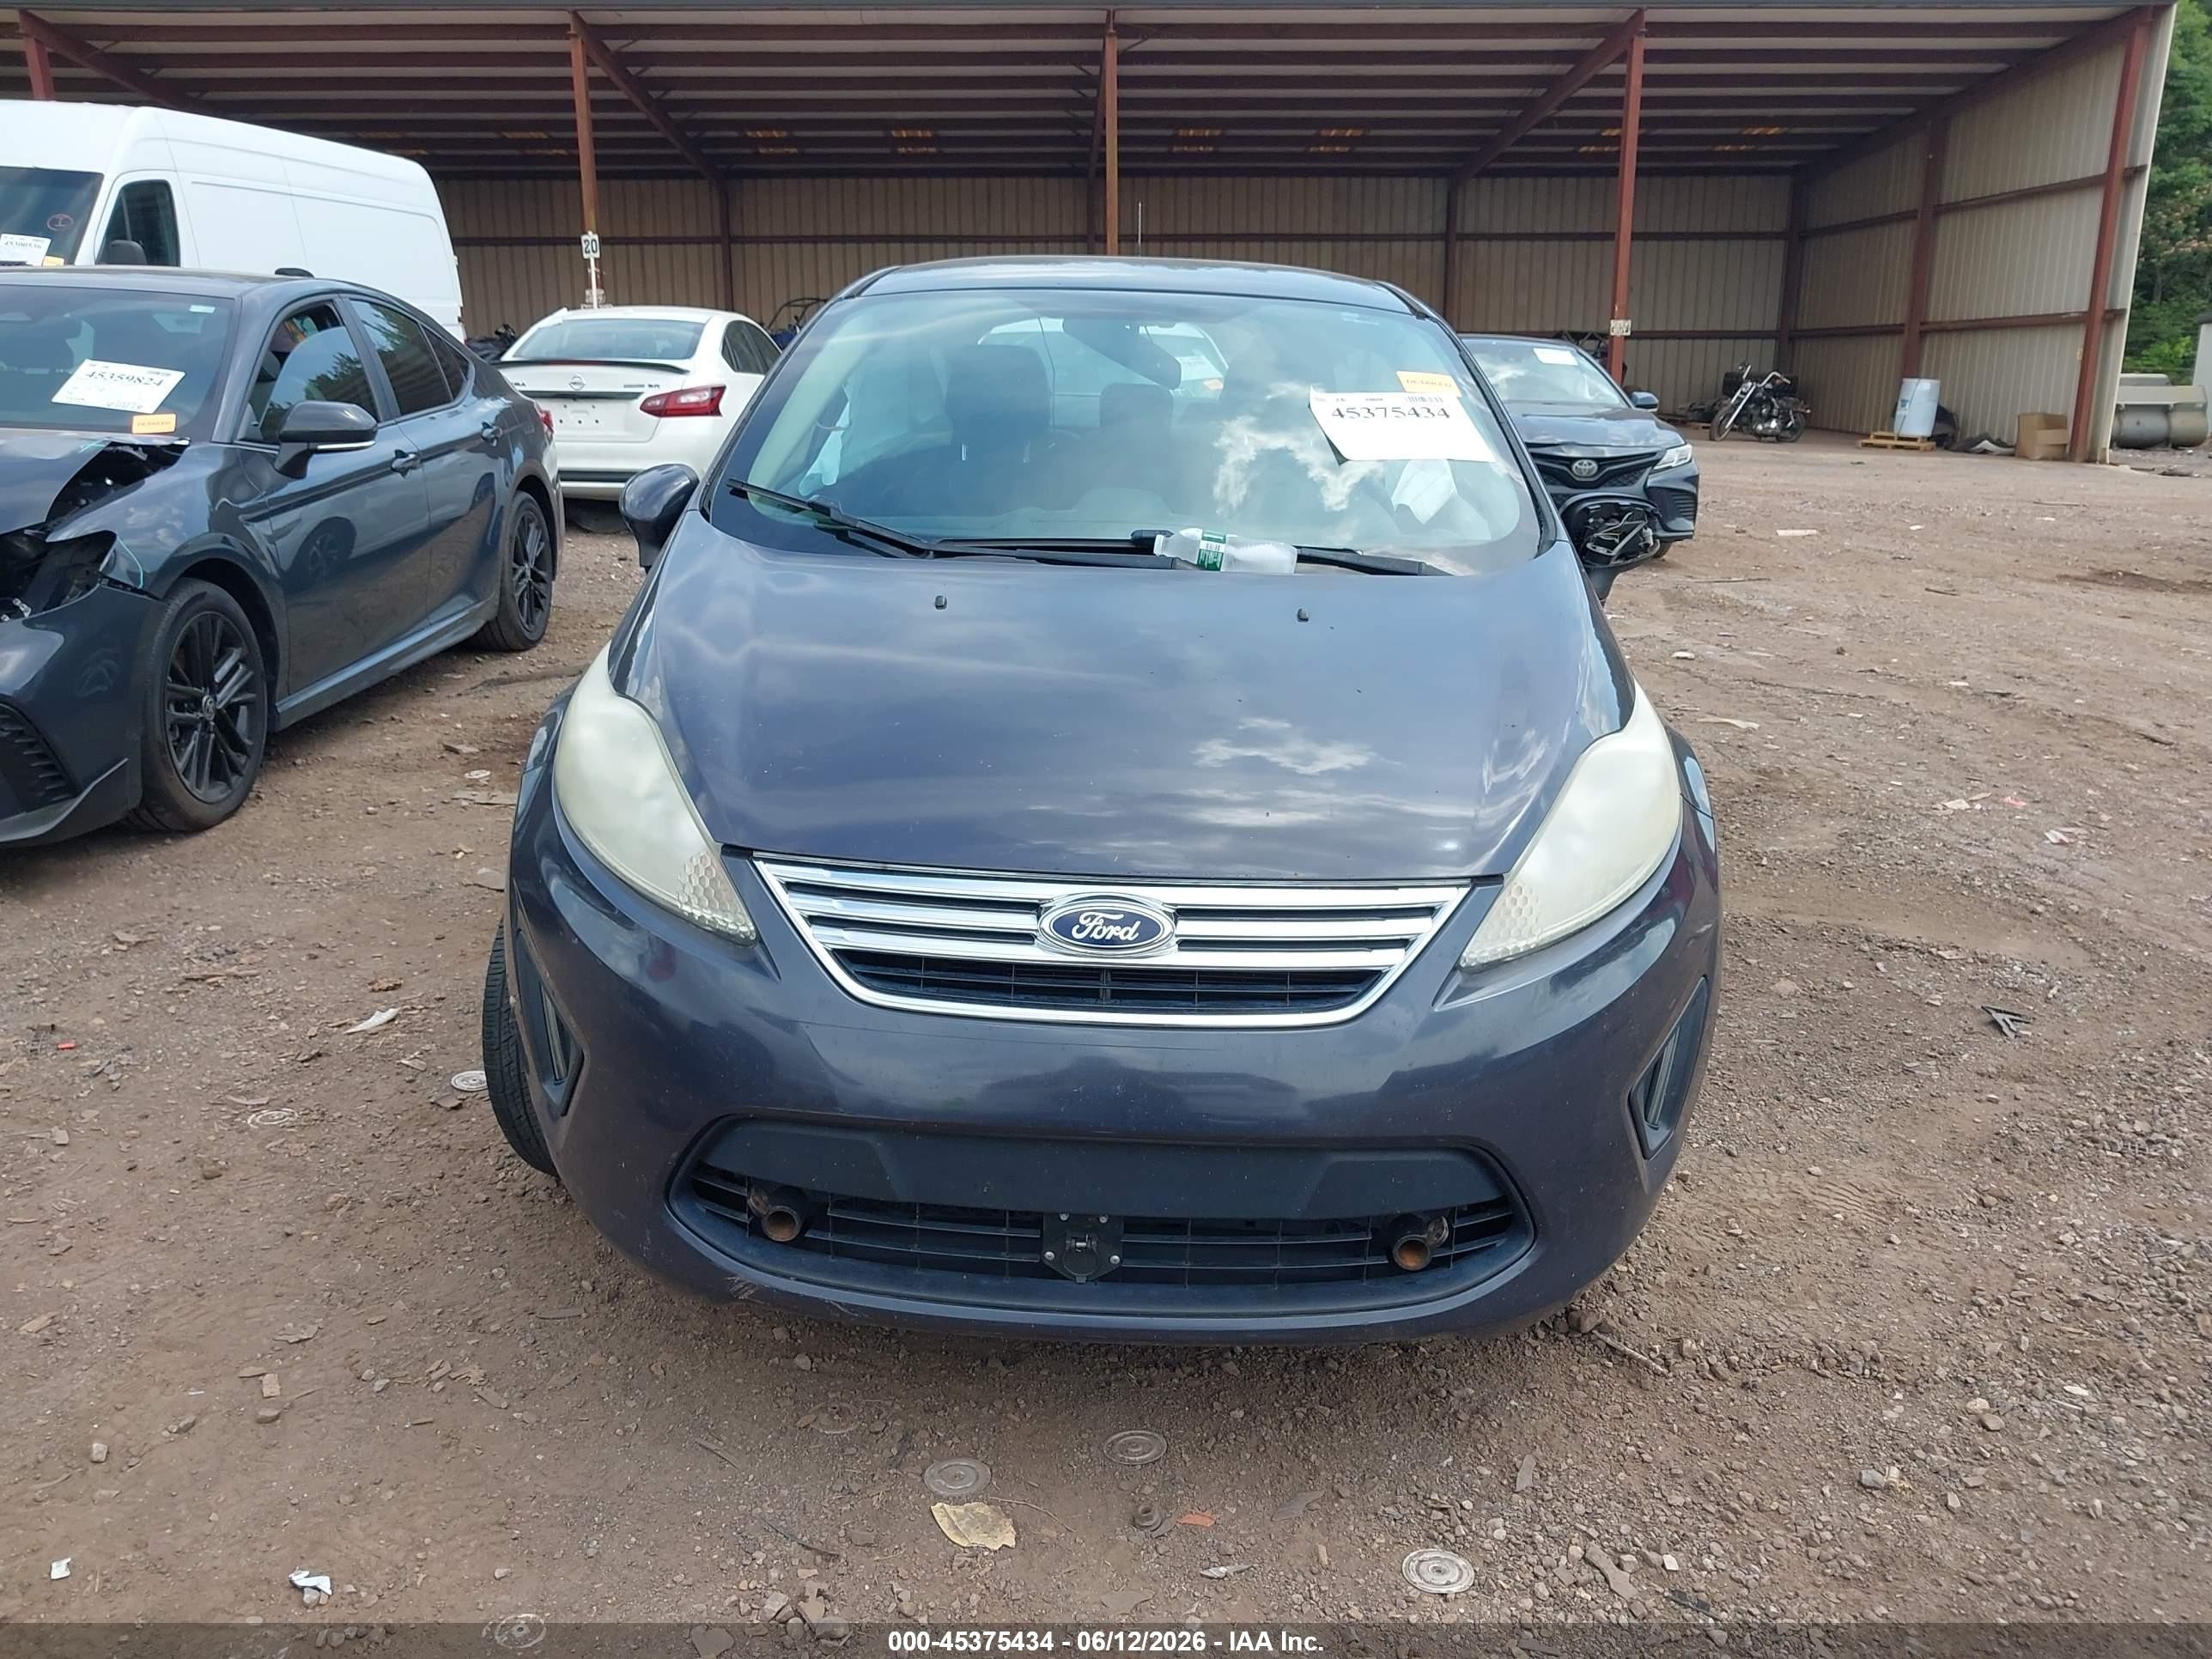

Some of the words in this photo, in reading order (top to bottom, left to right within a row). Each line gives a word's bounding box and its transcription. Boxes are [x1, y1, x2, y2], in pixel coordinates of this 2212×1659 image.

[583, 239, 598, 254] 20
[1332, 406, 1450, 419] 45375434
[1071, 911, 1141, 941] Ford
